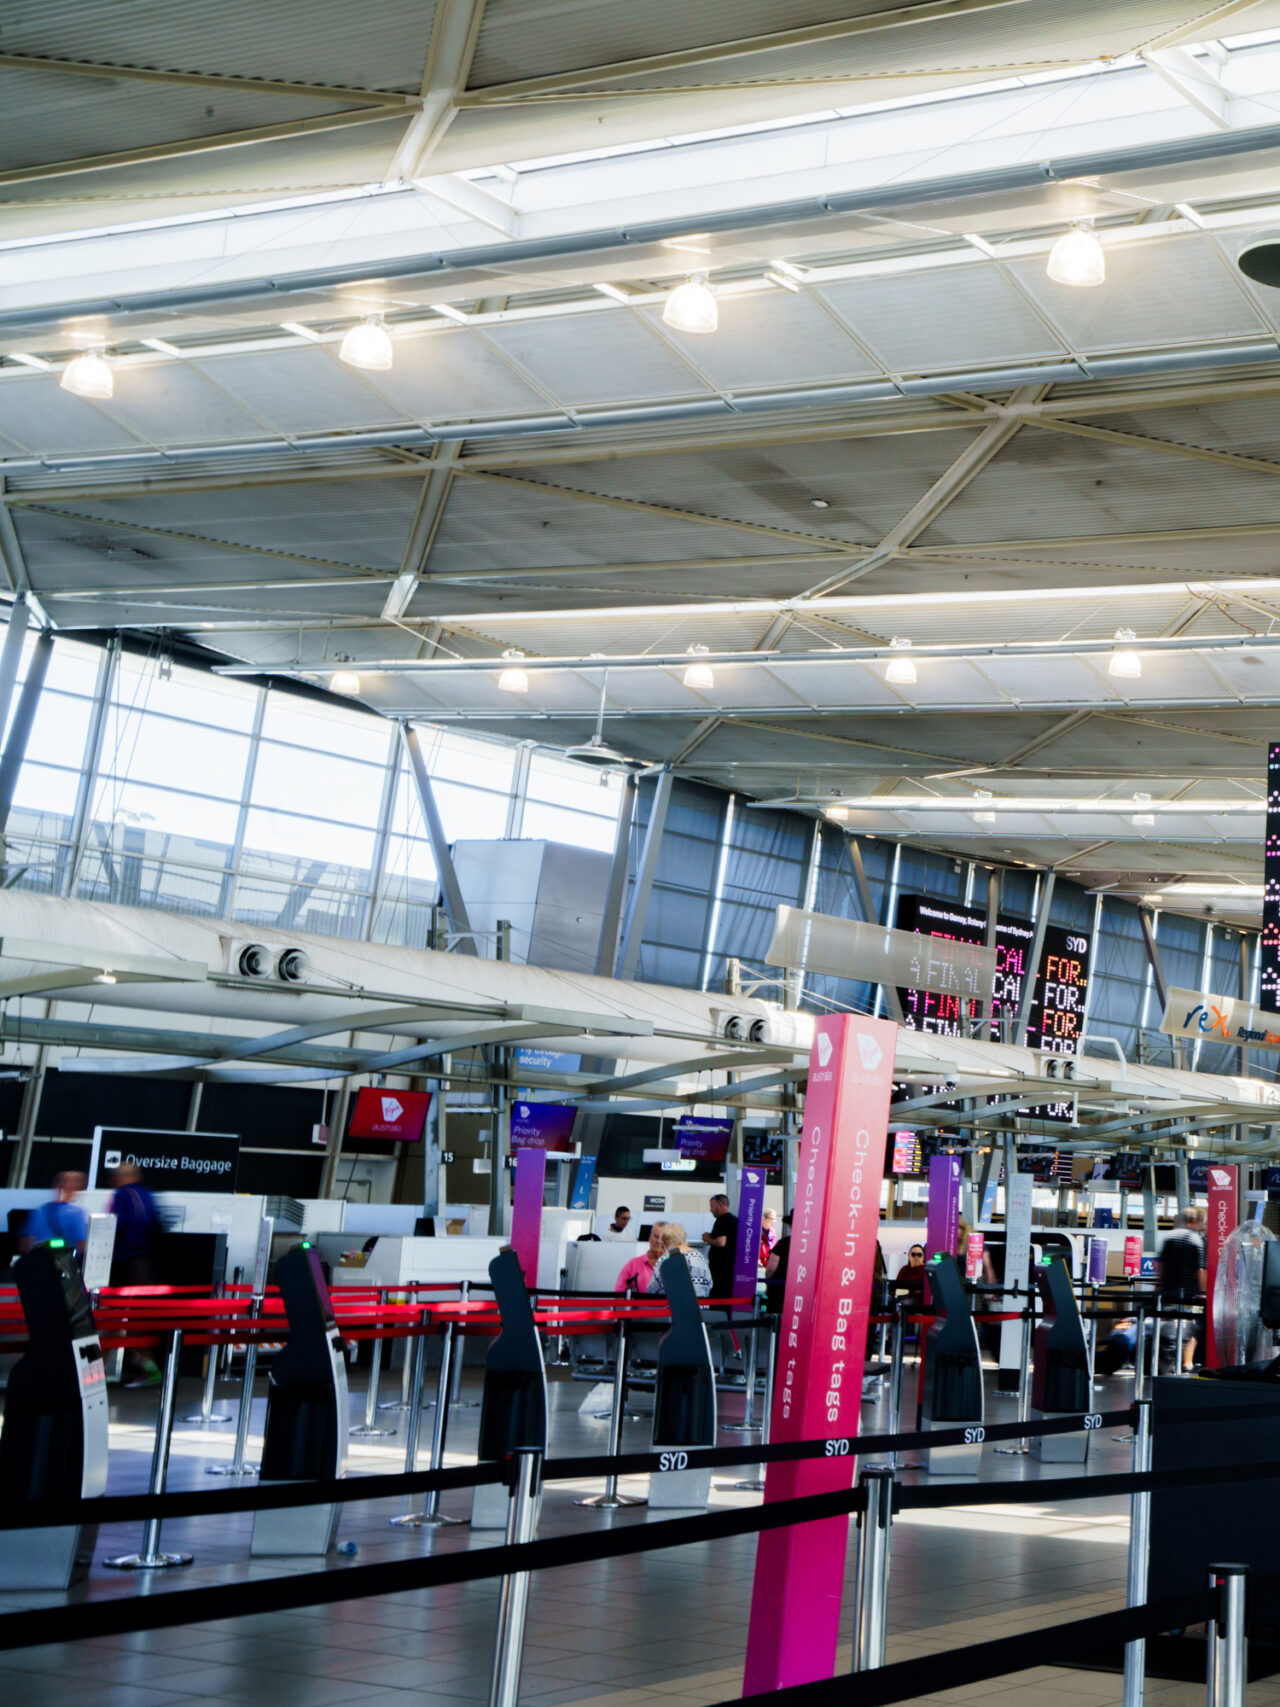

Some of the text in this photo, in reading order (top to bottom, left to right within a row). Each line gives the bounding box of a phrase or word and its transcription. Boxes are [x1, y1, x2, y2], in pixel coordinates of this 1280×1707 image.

[919, 905, 943, 920] Welcome
[1066, 936, 1087, 954] SYD
[519, 1055, 552, 1069] security
[372, 1123, 402, 1132] australia
[514, 1126, 541, 1137] Priority
[511, 1137, 545, 1146] Bag drop
[680, 1138, 704, 1148] Priority
[125, 1153, 232, 1175] Oversize Baggage
[443, 1152, 454, 1163] 15
[508, 1157, 518, 1168] 16
[746, 1198, 756, 1227] Priority
[744, 1227, 753, 1264] Check-in
[782, 1125, 822, 1420] Check-in & Bag tags
[825, 1128, 870, 1424] Check-in & Bag tags
[1084, 1413, 1103, 1430] SYD
[964, 1427, 985, 1444] SYD
[824, 1438, 850, 1456] SYD
[659, 1450, 689, 1472] SYD
